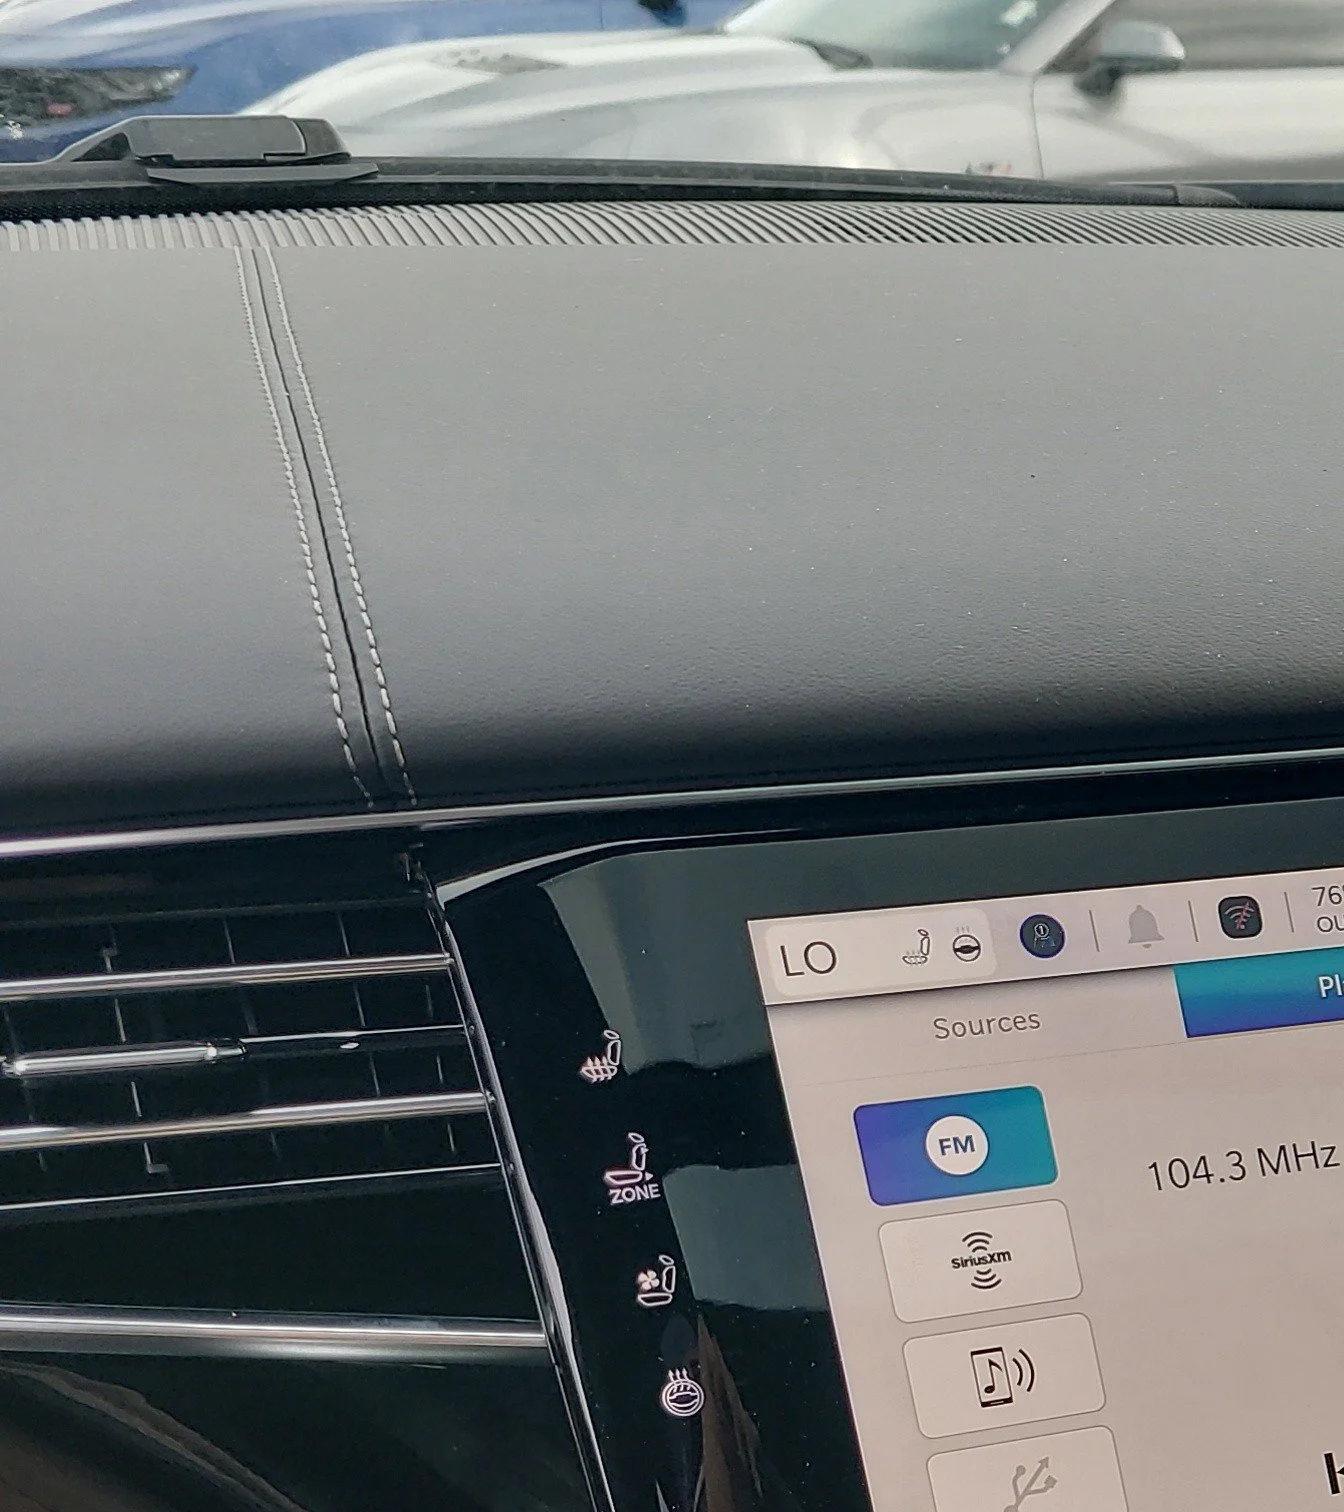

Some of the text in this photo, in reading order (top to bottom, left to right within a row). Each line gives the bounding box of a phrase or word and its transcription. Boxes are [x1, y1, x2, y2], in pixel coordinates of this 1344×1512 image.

[781, 939, 838, 979] LO
[933, 1010, 1042, 1041] Sources
[937, 1133, 976, 1158] FM
[1148, 1139, 1341, 1192] 104.3 MHz
[609, 1183, 660, 1204] ZONE
